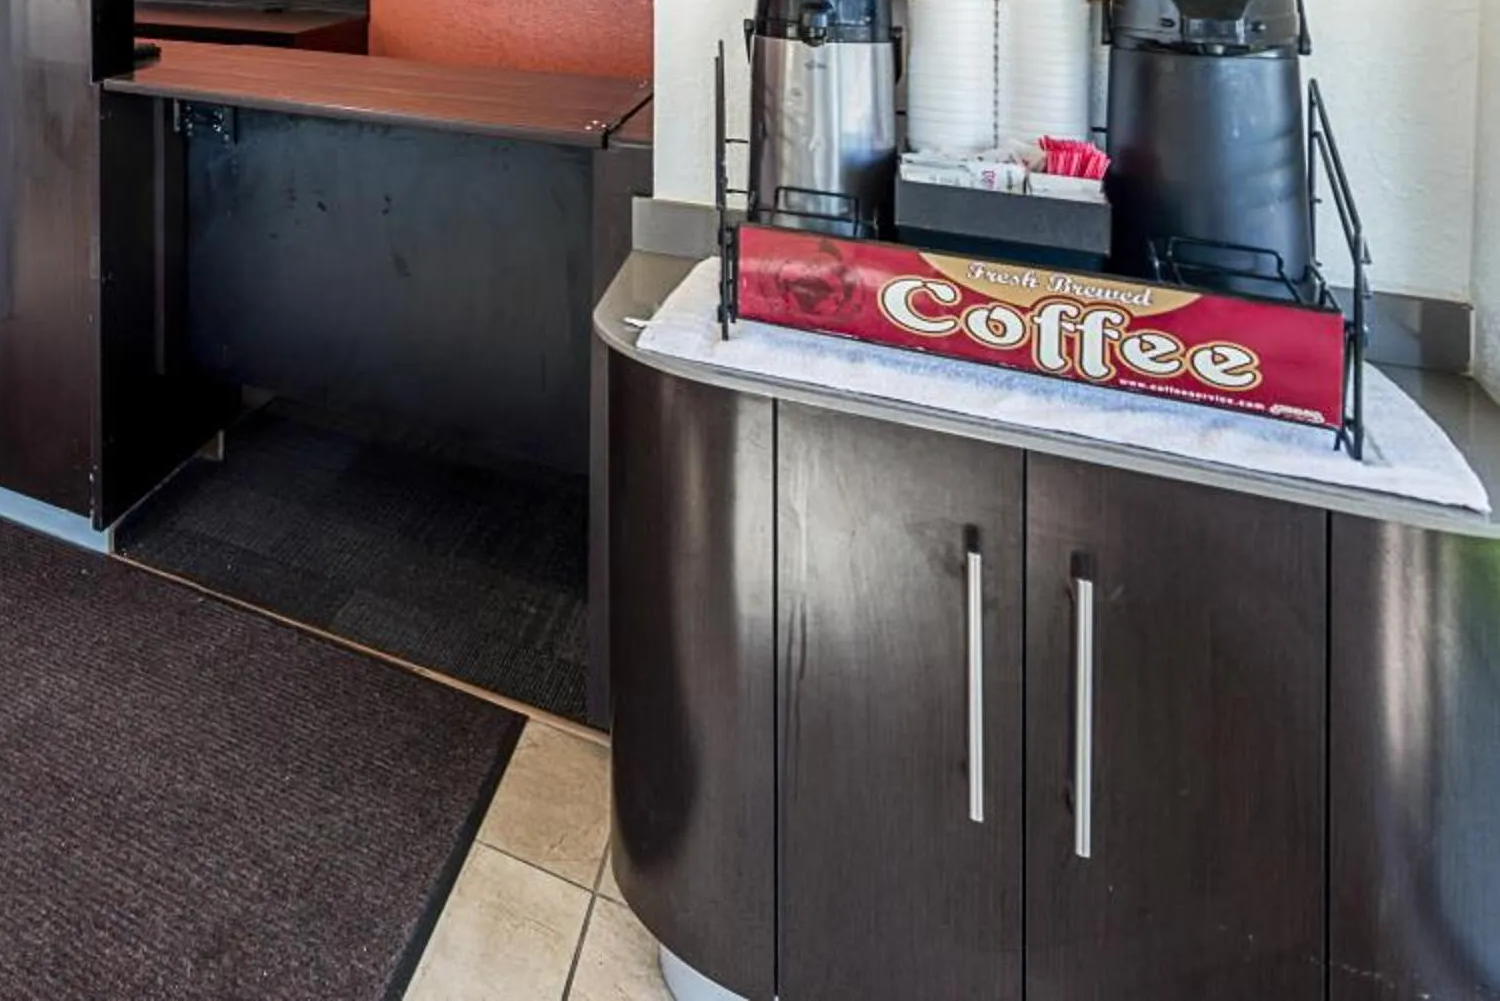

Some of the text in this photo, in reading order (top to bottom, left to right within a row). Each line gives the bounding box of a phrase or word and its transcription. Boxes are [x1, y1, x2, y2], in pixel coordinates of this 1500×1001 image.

[966, 262, 1153, 307] Fresh Brewed
[878, 278, 1262, 391] Coffee
